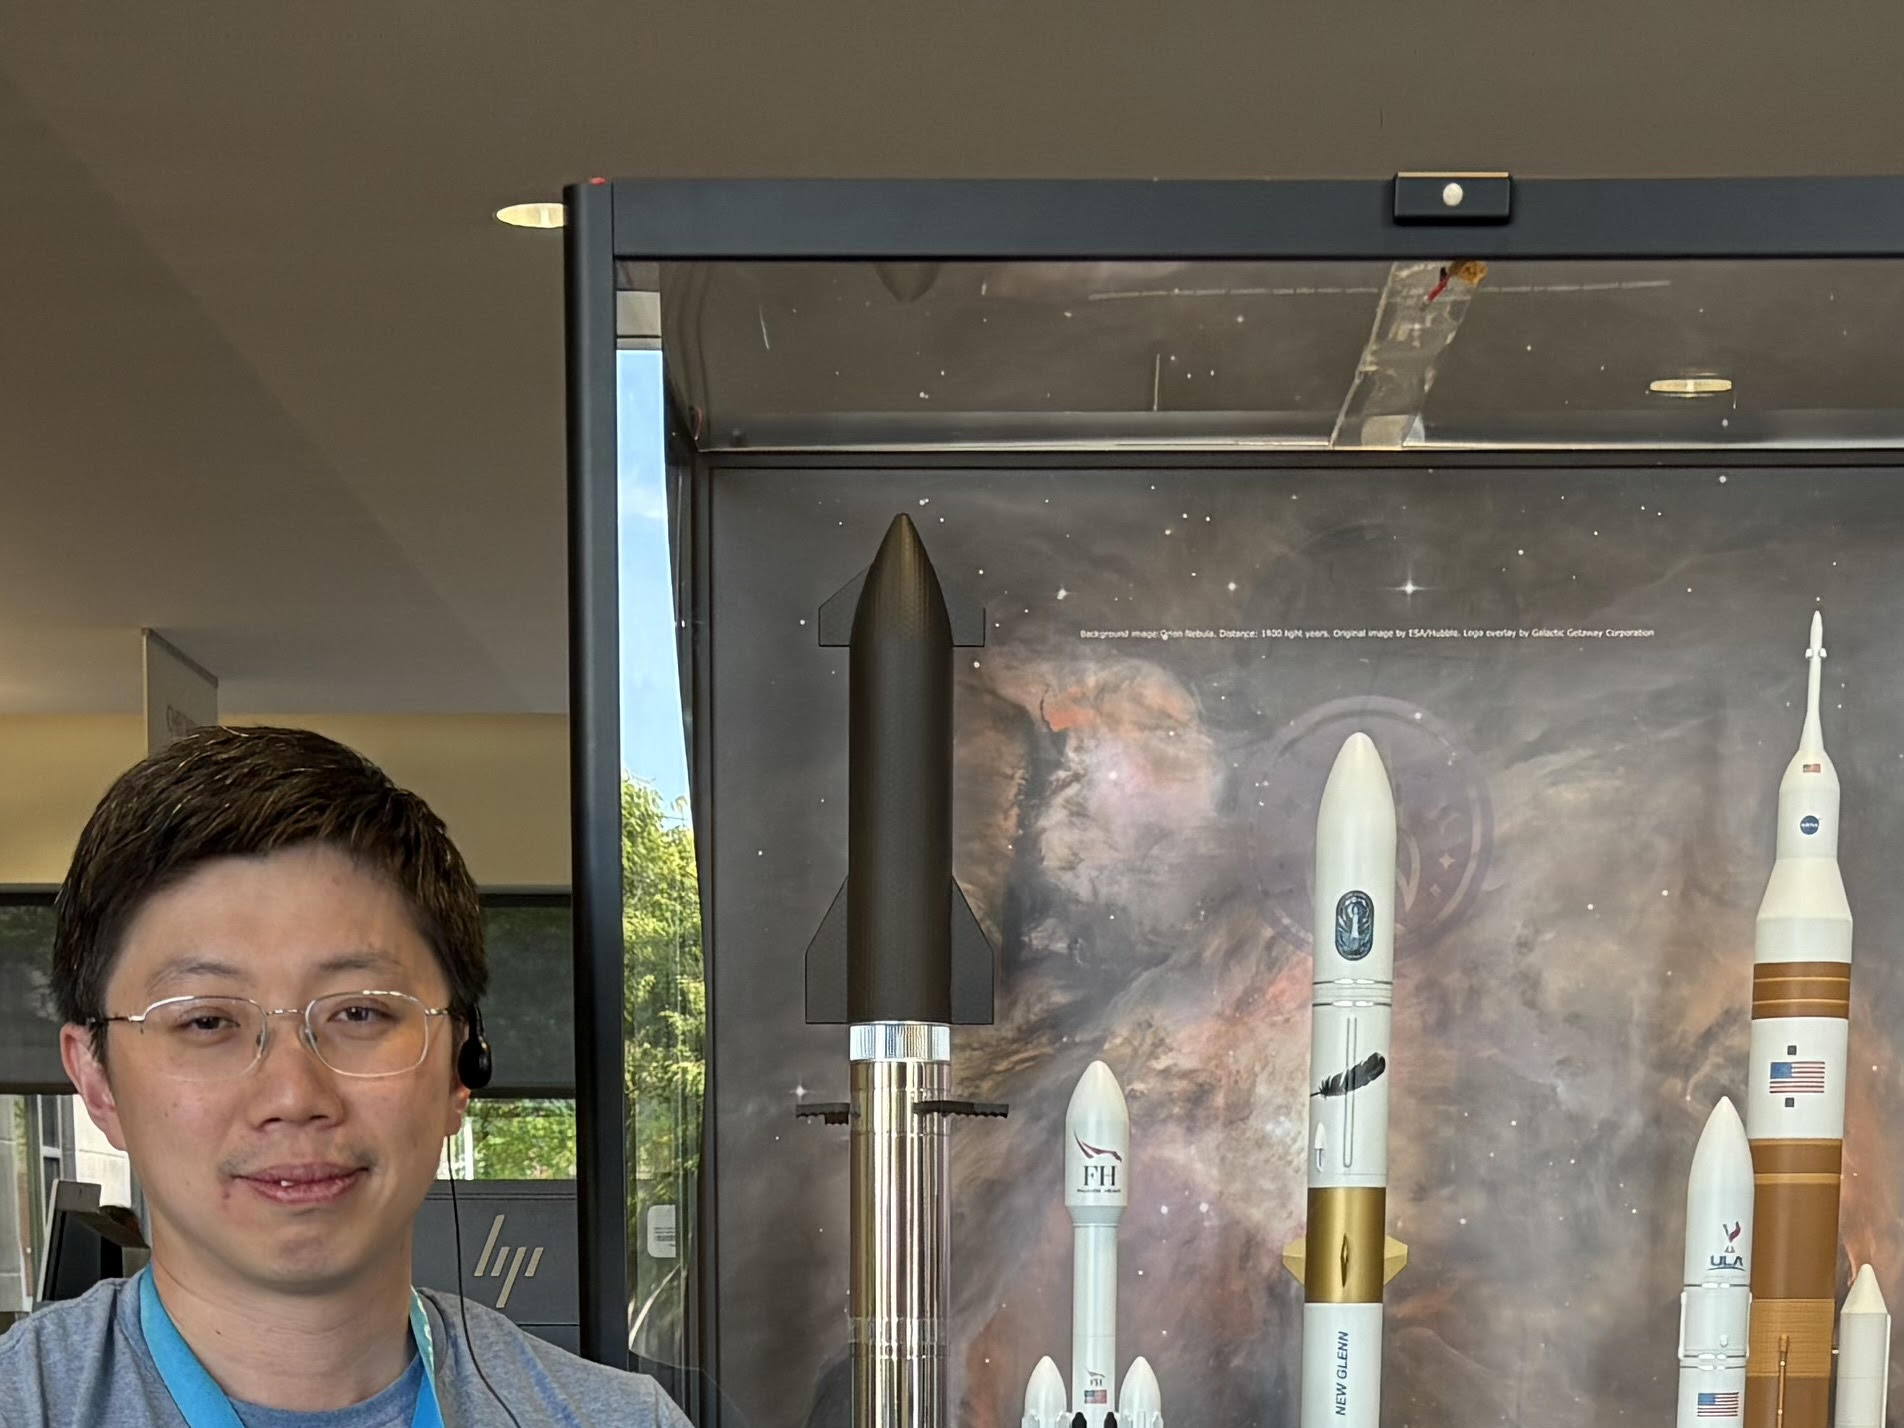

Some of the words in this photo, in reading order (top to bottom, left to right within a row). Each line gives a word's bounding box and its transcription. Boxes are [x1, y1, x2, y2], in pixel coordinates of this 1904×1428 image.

[1368, 629, 1394, 639] image
[1396, 629, 1406, 639] by
[1083, 1165, 1117, 1186] FH
[1336, 1331, 1349, 1377] GLENN
[1335, 1378, 1348, 1416] NEW
